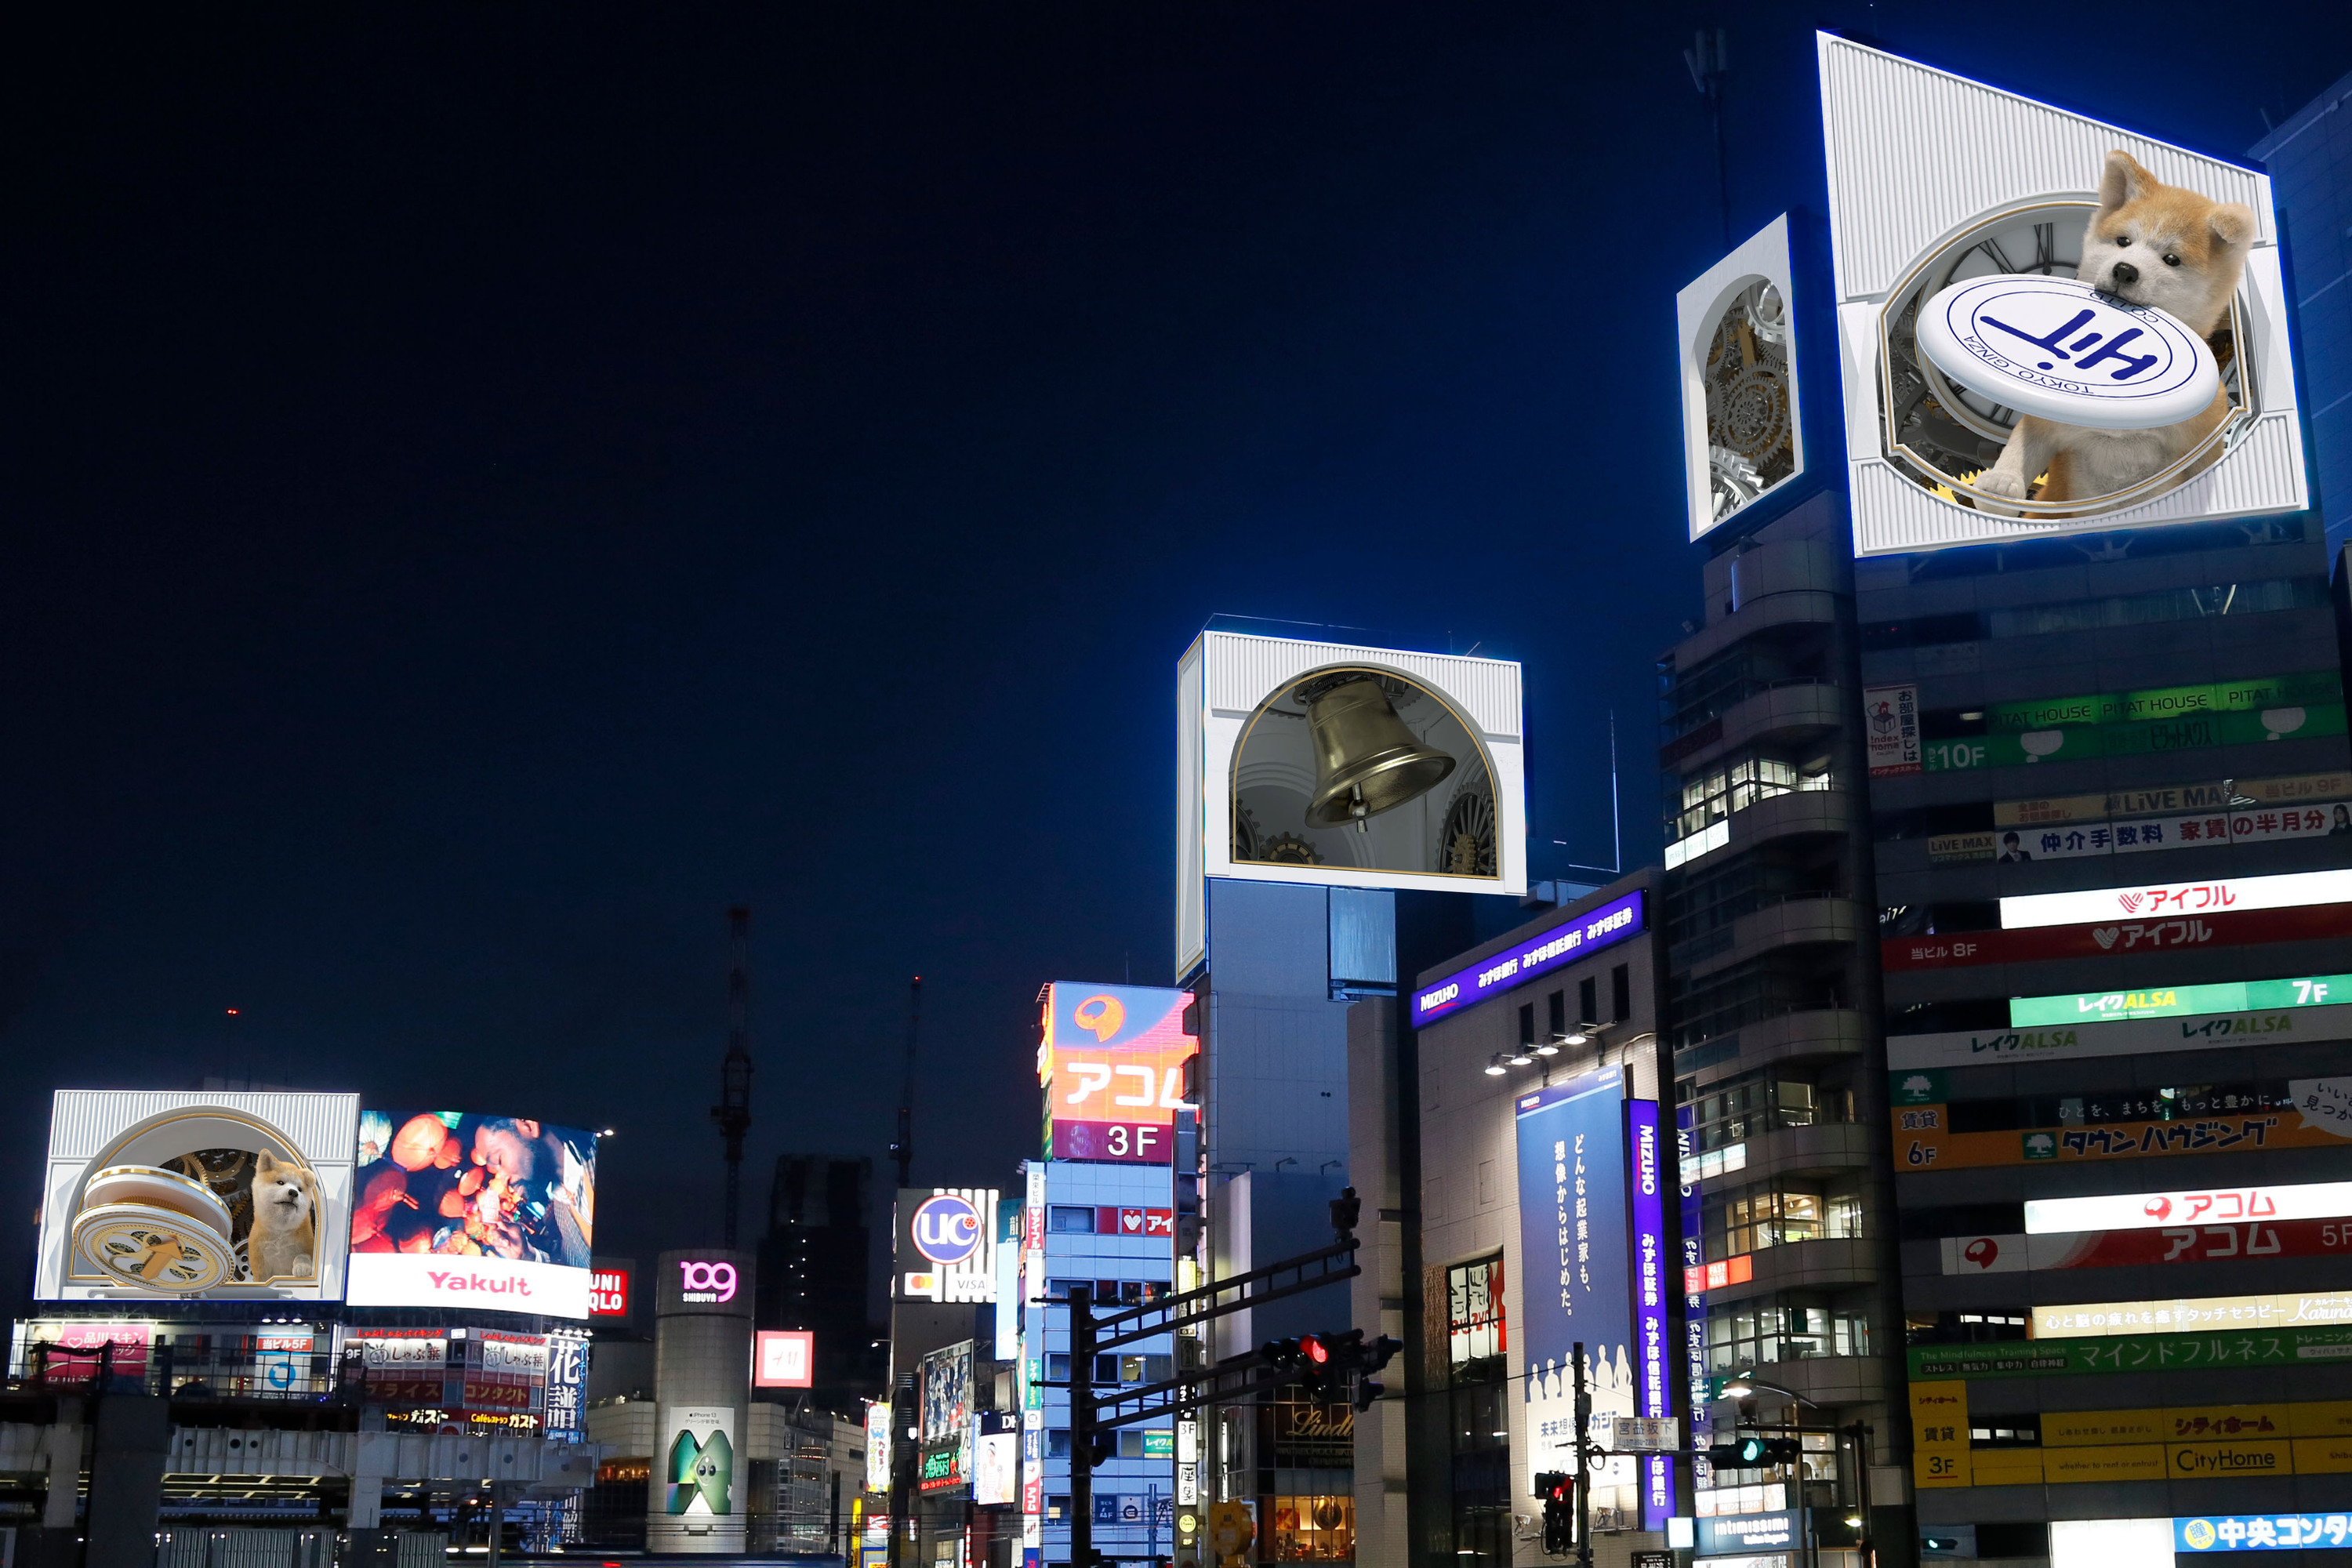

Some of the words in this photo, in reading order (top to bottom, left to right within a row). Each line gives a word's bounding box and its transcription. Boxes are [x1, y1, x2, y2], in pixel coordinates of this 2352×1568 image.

[1964, 336, 2009, 369] GINZA
[2019, 370, 2094, 394] TOKYO
[2102, 700, 2145, 717] PITAT
[2151, 694, 2207, 711] HOUSE
[2229, 688, 2271, 703] PITAT
[1898, 690, 1918, 762] お部屋探しは
[1987, 711, 2030, 726] PITAT
[2035, 706, 2092, 721] HOUSE
[1936, 743, 1985, 769] 10F
[1962, 835, 1992, 850] MAX
[2041, 823, 2163, 853] 仲介手数料
[2180, 810, 2325, 841] 家賃の半月分
[2147, 885, 2236, 911] アイフル
[2122, 920, 2212, 948] アイフル
[1420, 983, 1459, 1012] MIZUHO
[1478, 958, 1519, 988] みずほ銀行
[1523, 929, 1581, 969] みずほ信託銀行
[1586, 907, 1633, 941] みずほ証券
[1911, 946, 1948, 960] 当ビル
[1953, 943, 1977, 958] 8F
[2078, 990, 2177, 1014] レイクALSA
[2292, 980, 2328, 1004] 7F
[2182, 1014, 2292, 1039] レイクALSA
[1971, 1030, 2078, 1053] レイクALSA
[1521, 1096, 1540, 1109] MIZUHO
[1900, 1110, 1938, 1130] 賃貸
[1107, 1125, 1159, 1157] 3F
[2062, 1118, 2278, 1156] タウンハウジング
[1639, 1124, 1655, 1196] MIZUHO
[1907, 1140, 1936, 1165] 6F
[1574, 1134, 1592, 1292] どんな起業家も、
[2184, 1191, 2276, 1221] アコム
[1031, 1216, 1040, 1249] アイフル
[1555, 1140, 1573, 1316] 想像からはじめた。
[2161, 1223, 2281, 1261] アコム
[1642, 1233, 1659, 1307] みずほ証券
[1709, 1264, 1726, 1275] FAST
[427, 1272, 532, 1297] Yakult
[590, 1273, 621, 1292] UNI
[680, 1261, 737, 1303] 109
[957, 1279, 985, 1290] VISA
[589, 1293, 622, 1312] QLO
[683, 1292, 717, 1303] SHIBUYA
[392, 1345, 441, 1361] しゃぶ葉
[504, 1351, 545, 1367] しゃぶ葉
[1921, 1352, 1937, 1361] The
[1940, 1348, 1997, 1360] Mindfulness
[2000, 1346, 2037, 1359] Training
[2039, 1345, 2067, 1356] Space
[2078, 1338, 2285, 1367] マインドフルネス
[1645, 1316, 1663, 1418] みずほ信託銀行
[466, 1385, 527, 1403] コンタクト
[509, 1414, 539, 1429] ガスト
[1180, 1424, 1195, 1434] 3F
[1618, 1421, 1672, 1436] 宮益坂下
[2176, 1416, 2275, 1436] シティホーム
[1924, 1426, 1955, 1443] 賃貸
[1929, 1457, 1954, 1474] 3F
[2176, 1450, 2275, 1471] CityHome
[2218, 1515, 2352, 1549] 中央コンタ
